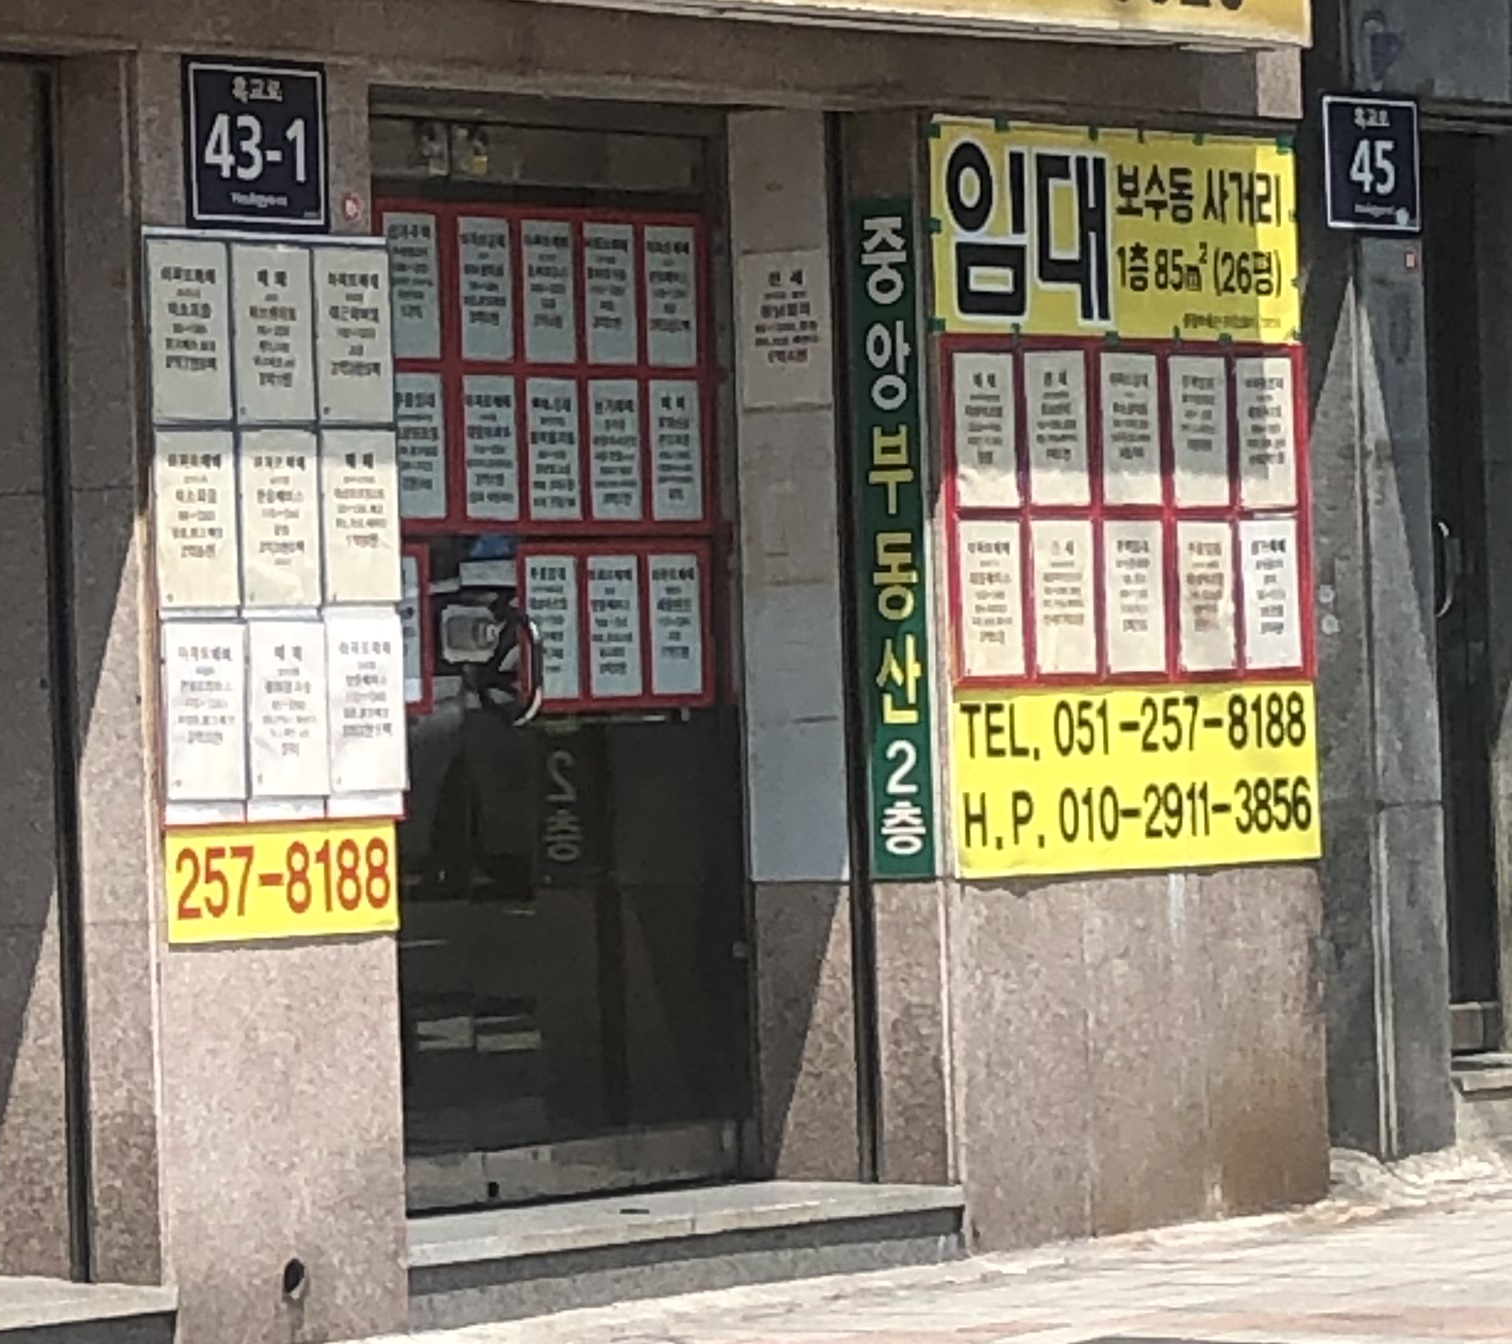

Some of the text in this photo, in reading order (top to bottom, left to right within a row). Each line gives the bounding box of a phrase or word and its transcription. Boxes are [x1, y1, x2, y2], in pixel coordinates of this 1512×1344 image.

[204, 112, 306, 184] 43-1
[1349, 138, 1396, 195] 45
[945, 140, 1112, 320] 임대
[1115, 163, 1282, 228] 보수동 사거리
[1116, 242, 1150, 293] 1층
[1214, 247, 1282, 299] (26평)
[959, 690, 1308, 762] TEL. 051-257-8188
[879, 739, 927, 857] 2층
[961, 775, 1313, 851] H.P. 010-2911-3856
[174, 836, 391, 921] 257-8188
